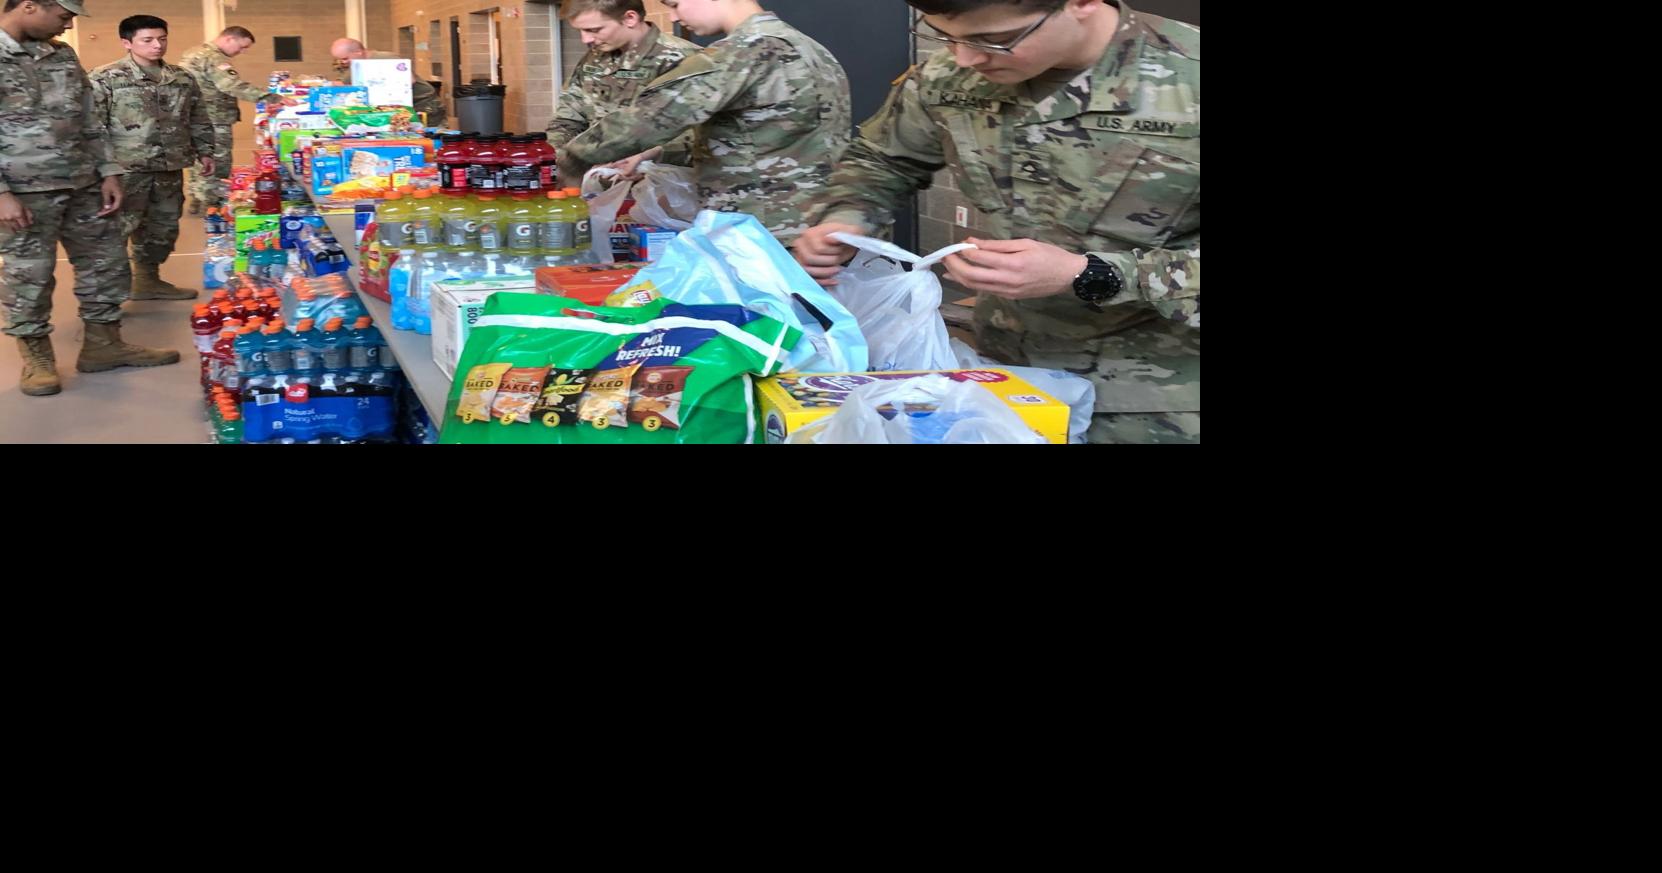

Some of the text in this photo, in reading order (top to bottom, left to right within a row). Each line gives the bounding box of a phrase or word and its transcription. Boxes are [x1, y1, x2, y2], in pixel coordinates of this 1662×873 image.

[1096, 116, 1176, 133] U.S. ARMY
[516, 225, 531, 236] G
[576, 220, 588, 231] G
[467, 307, 478, 324] 800
[641, 332, 665, 347] MIX
[615, 345, 682, 361] REFRESH!
[466, 380, 494, 388] BAKED
[357, 397, 370, 406] 24
[284, 407, 315, 415] Natural
[547, 415, 555, 423] 4
[597, 418, 605, 426] 3
[648, 419, 656, 428] 3
